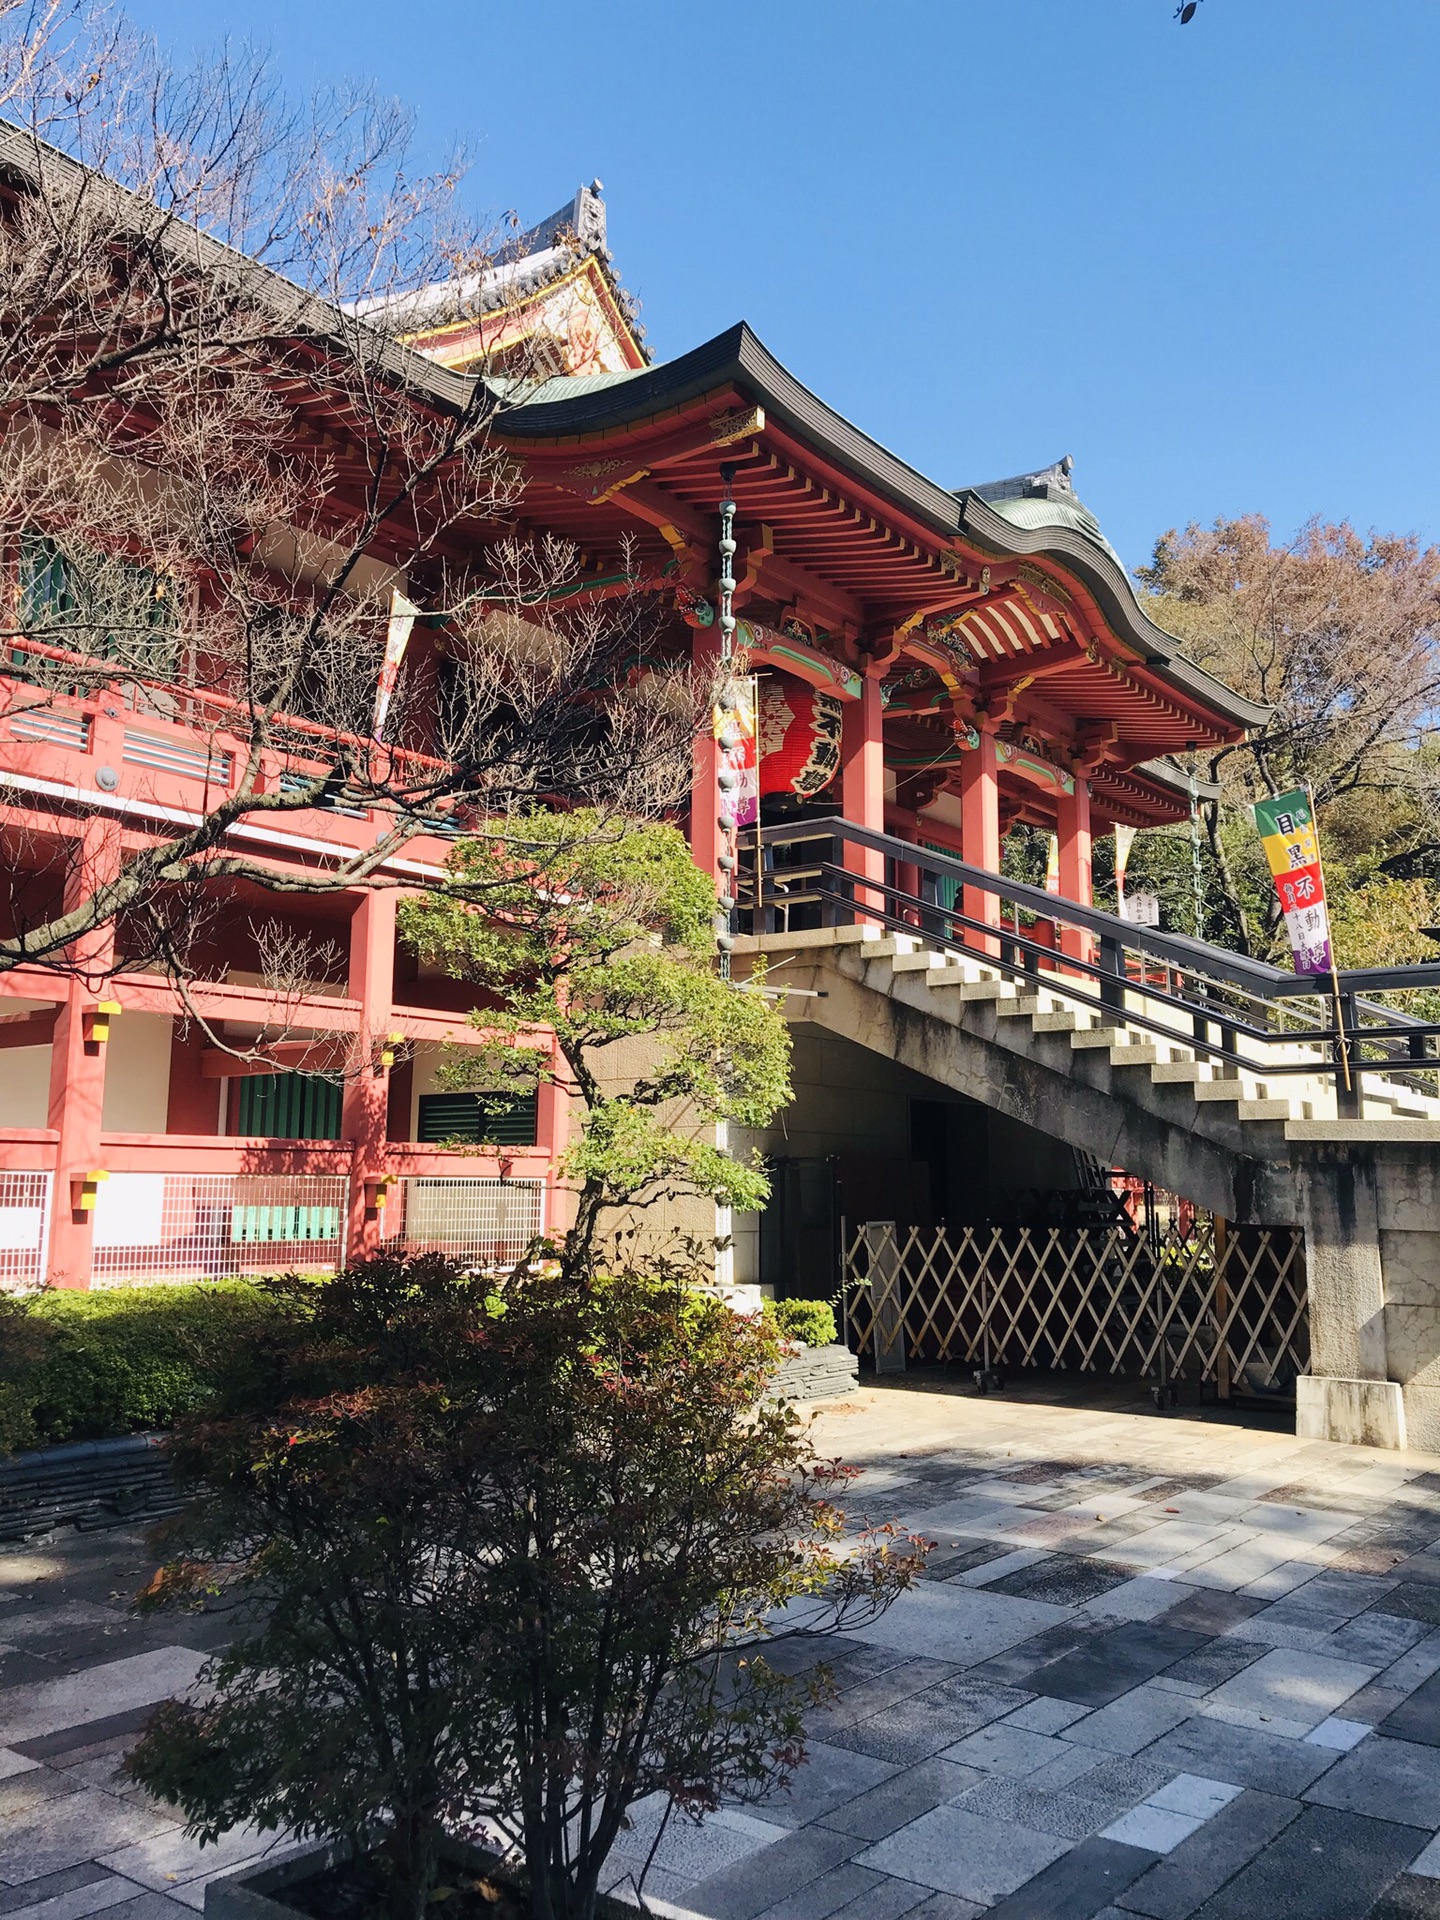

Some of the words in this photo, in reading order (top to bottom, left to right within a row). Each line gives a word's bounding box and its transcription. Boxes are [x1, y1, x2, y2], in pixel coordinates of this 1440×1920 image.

[1276, 812, 1326, 964] 目黒不動尊
